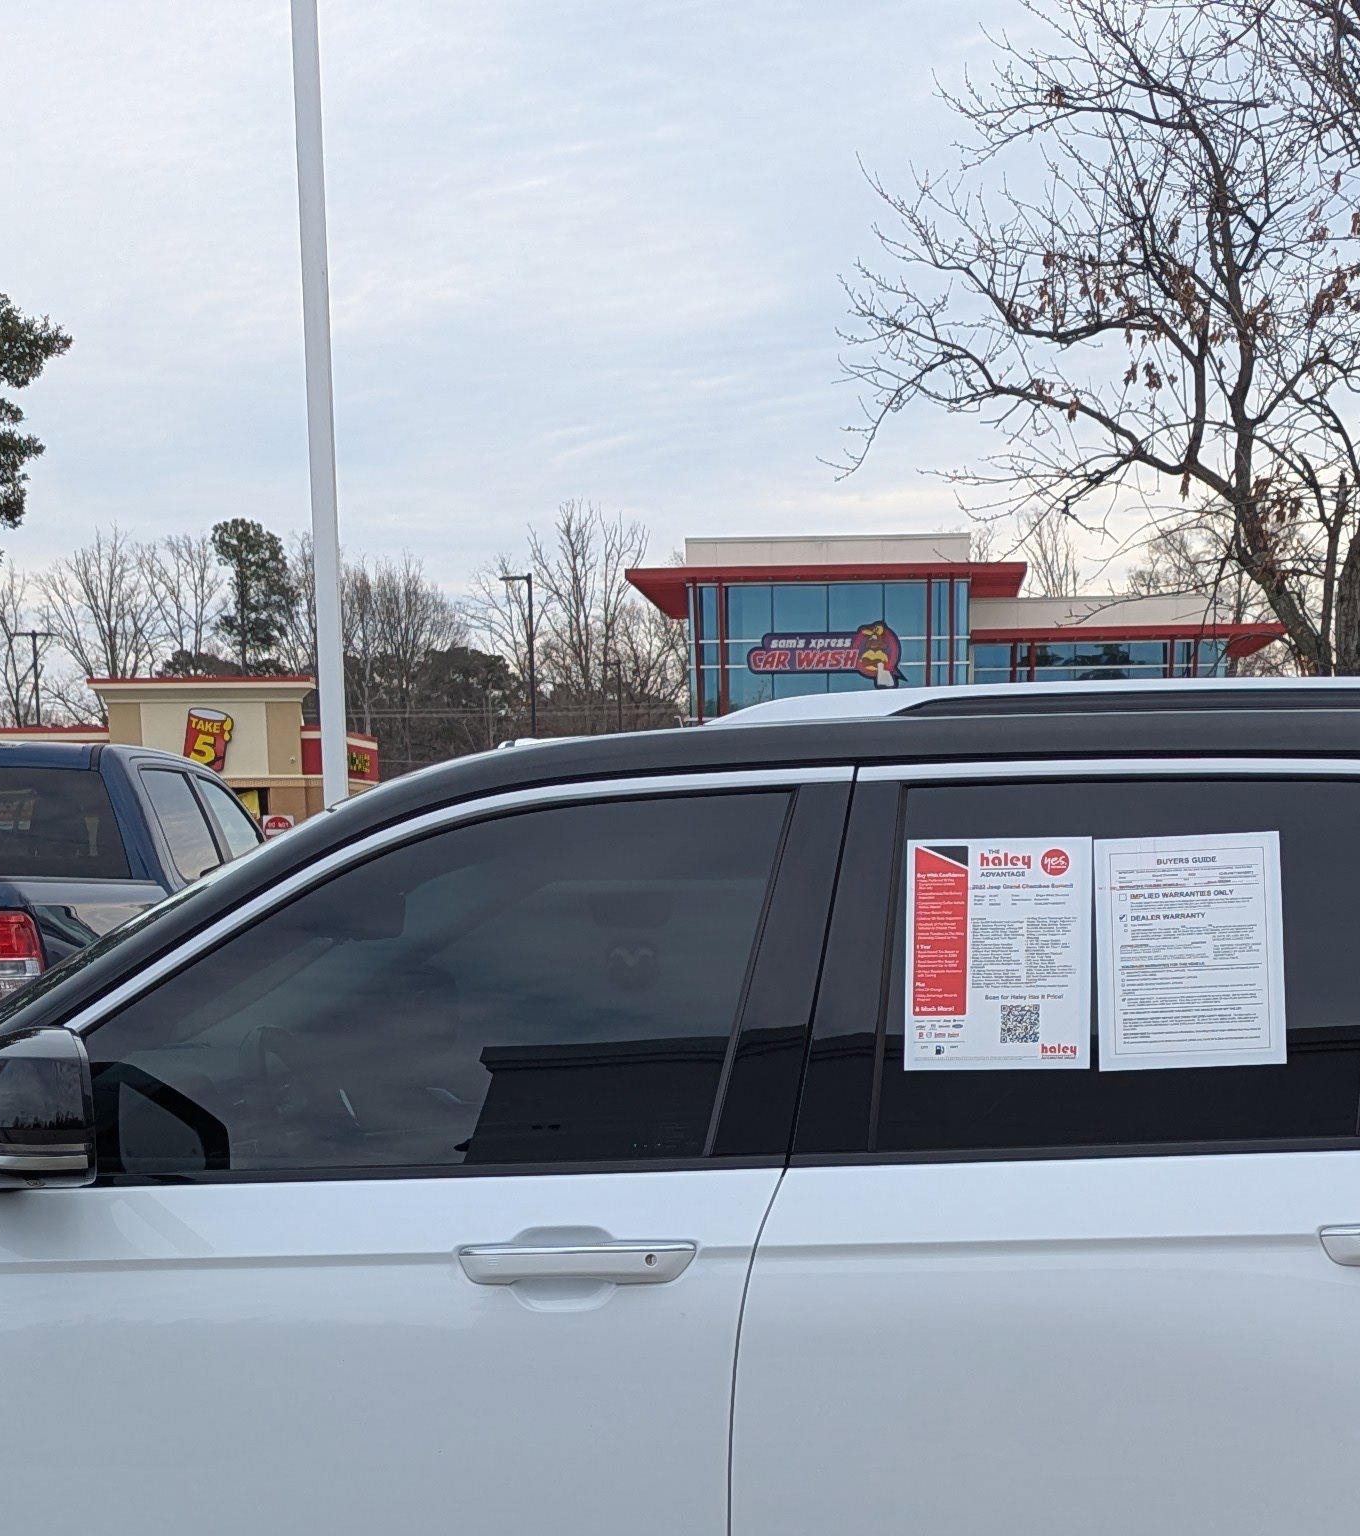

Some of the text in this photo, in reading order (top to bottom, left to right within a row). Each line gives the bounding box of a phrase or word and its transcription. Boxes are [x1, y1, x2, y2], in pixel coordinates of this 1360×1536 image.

[770, 636, 852, 649] sam's xpress
[750, 649, 859, 671] CAR WASH
[190, 717, 222, 733] TAKE
[189, 734, 216, 765] 5
[980, 852, 1031, 869] haley
[1156, 856, 1217, 865] BUYERS GUIDE
[980, 870, 1026, 878] ADVANTAGE
[1130, 889, 1234, 900] IMPLIED WARRANTIES ONLY
[1130, 912, 1206, 922] DEALER WARRANTY
[1040, 1043, 1077, 1056] haley
